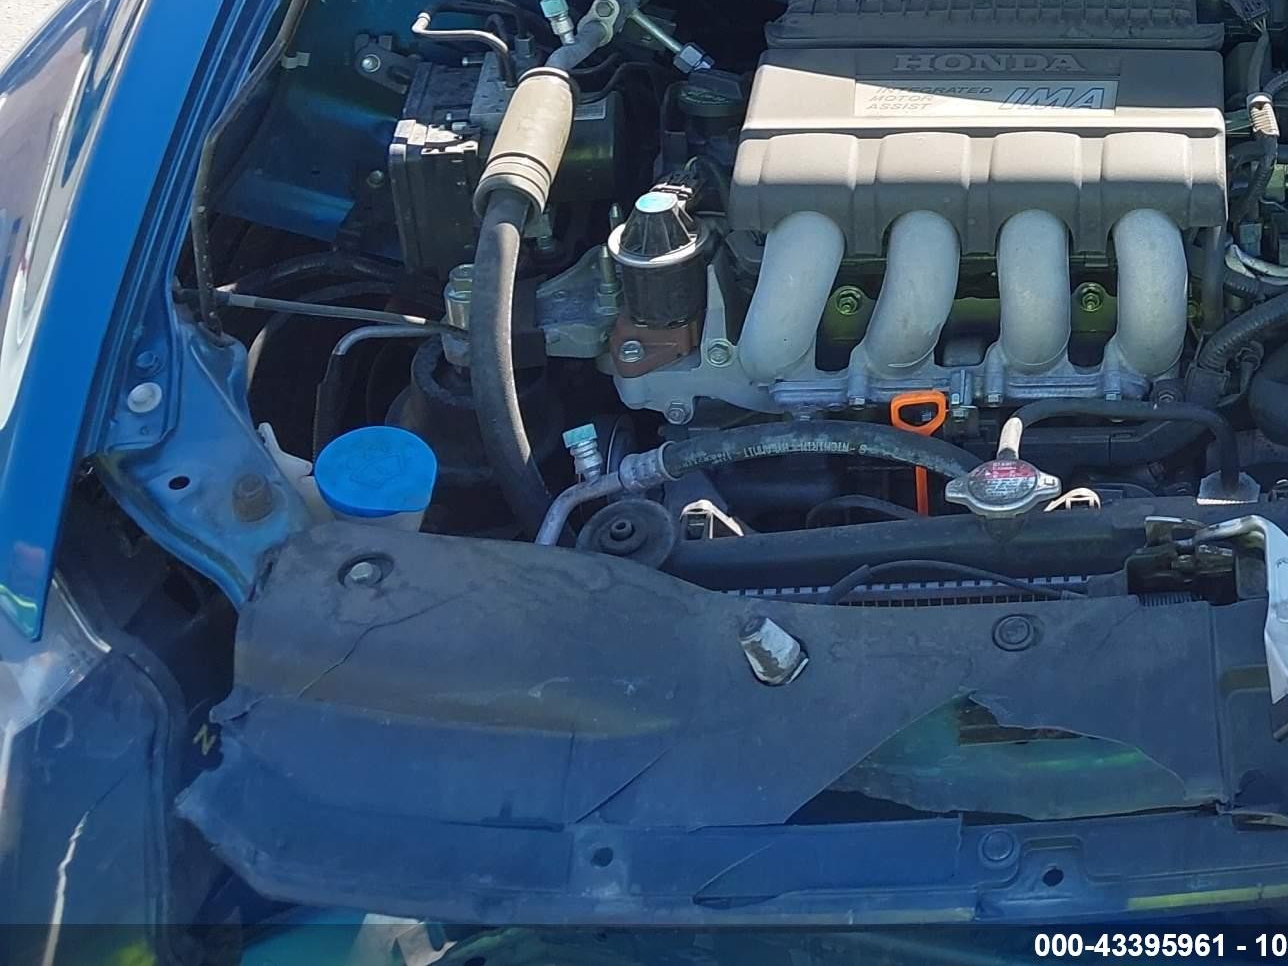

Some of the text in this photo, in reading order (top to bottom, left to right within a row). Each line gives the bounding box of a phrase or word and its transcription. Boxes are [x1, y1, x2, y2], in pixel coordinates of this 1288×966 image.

[893, 53, 1085, 73] HONDA
[876, 86, 993, 95] INTEGRATED
[998, 87, 1106, 110] IMA
[865, 103, 933, 111] ASSIST
